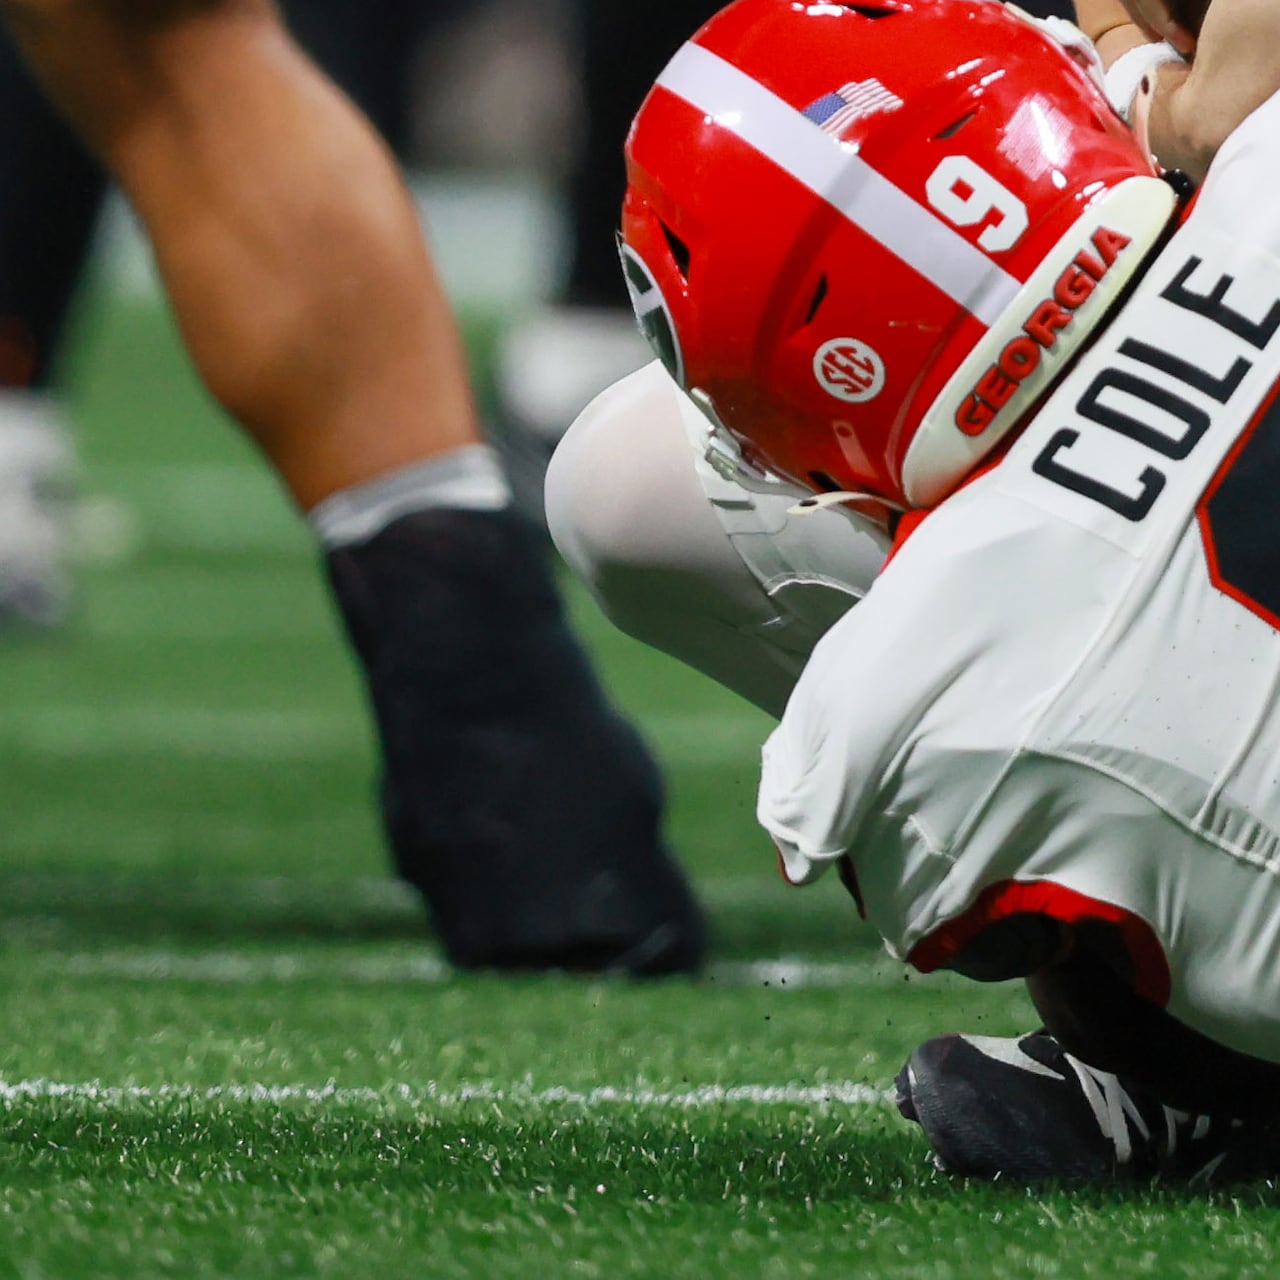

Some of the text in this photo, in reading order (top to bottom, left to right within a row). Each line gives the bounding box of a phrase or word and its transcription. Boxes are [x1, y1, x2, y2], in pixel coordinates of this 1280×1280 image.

[925, 154, 1030, 253] 9
[821, 345, 876, 395] SEC
[954, 225, 1133, 438] GEORGIA
